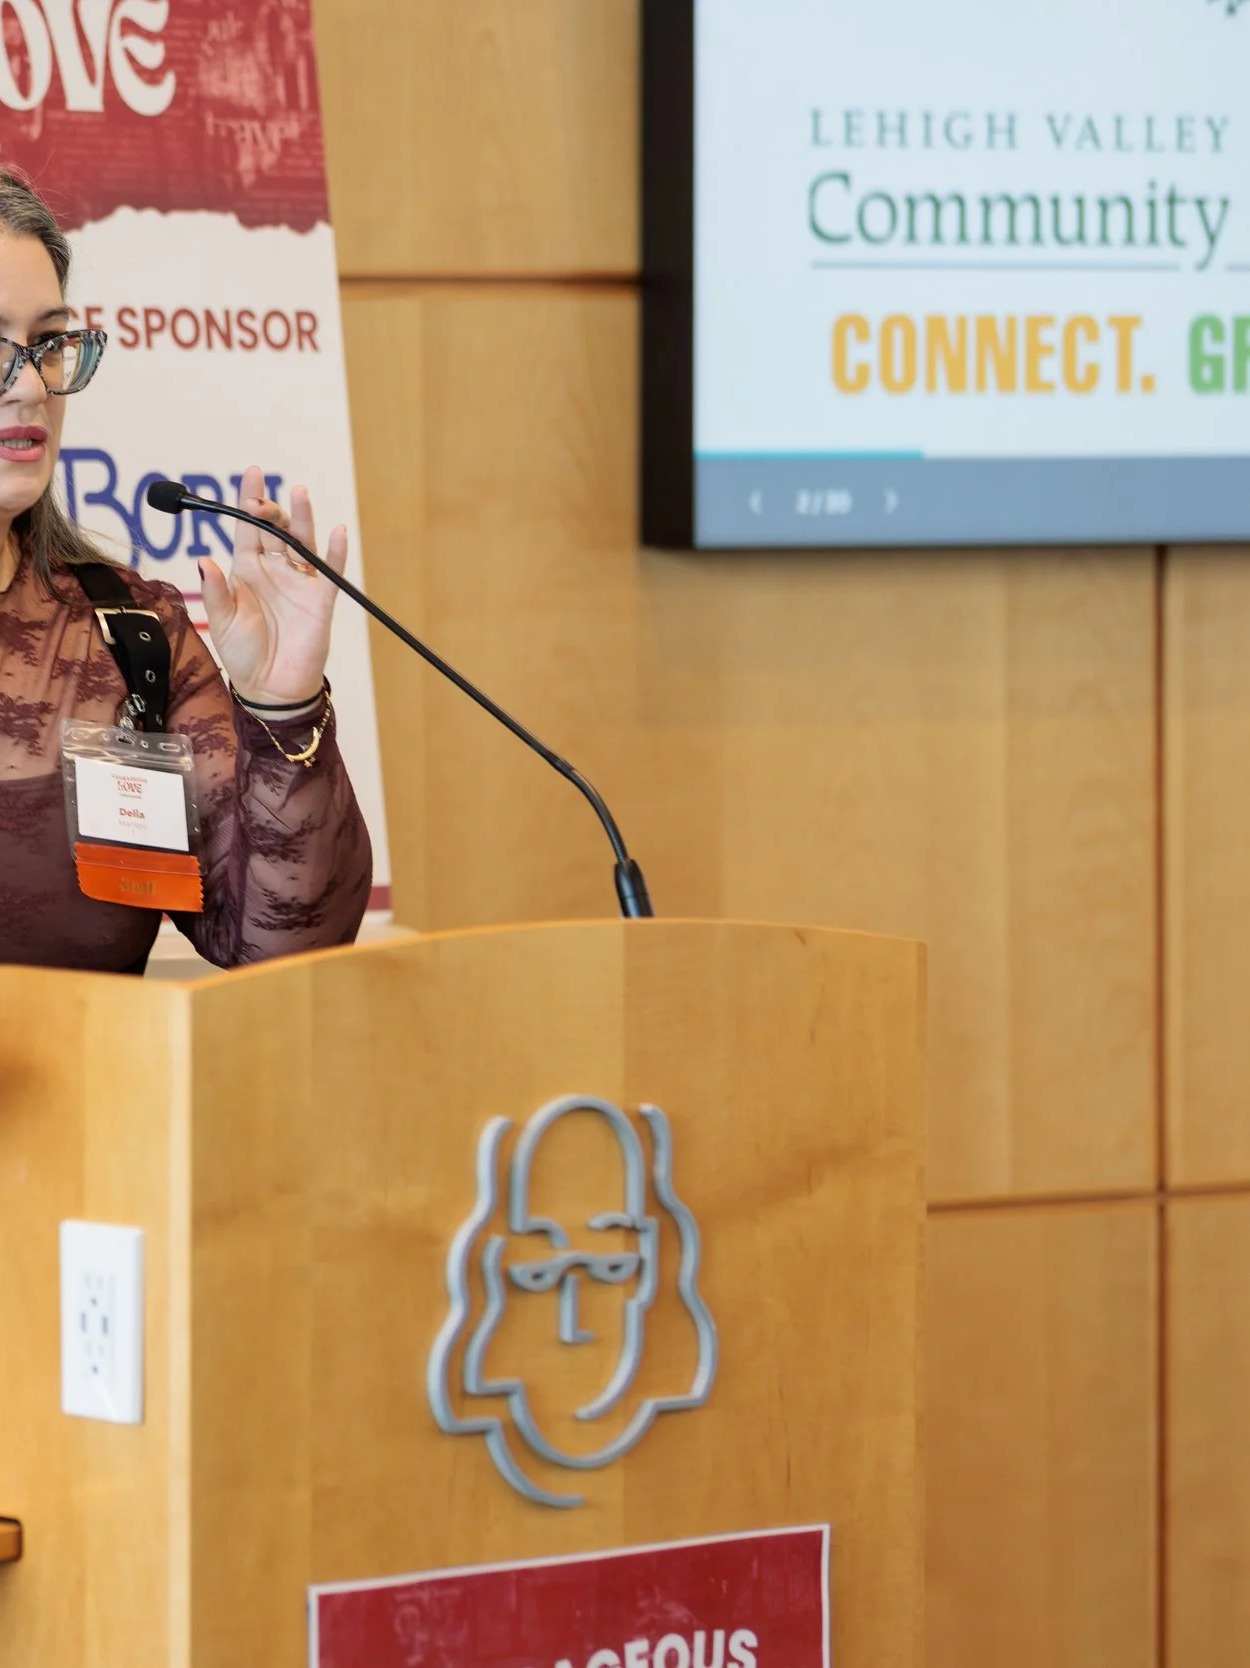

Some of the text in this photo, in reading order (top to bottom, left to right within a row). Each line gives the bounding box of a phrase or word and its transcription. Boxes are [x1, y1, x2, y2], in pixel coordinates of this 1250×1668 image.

[810, 108, 1231, 153] LEHIGH VALLEY
[808, 171, 1230, 271] Community
[116, 306, 321, 353] SPONSOR
[831, 313, 1156, 395] CONNECT.
